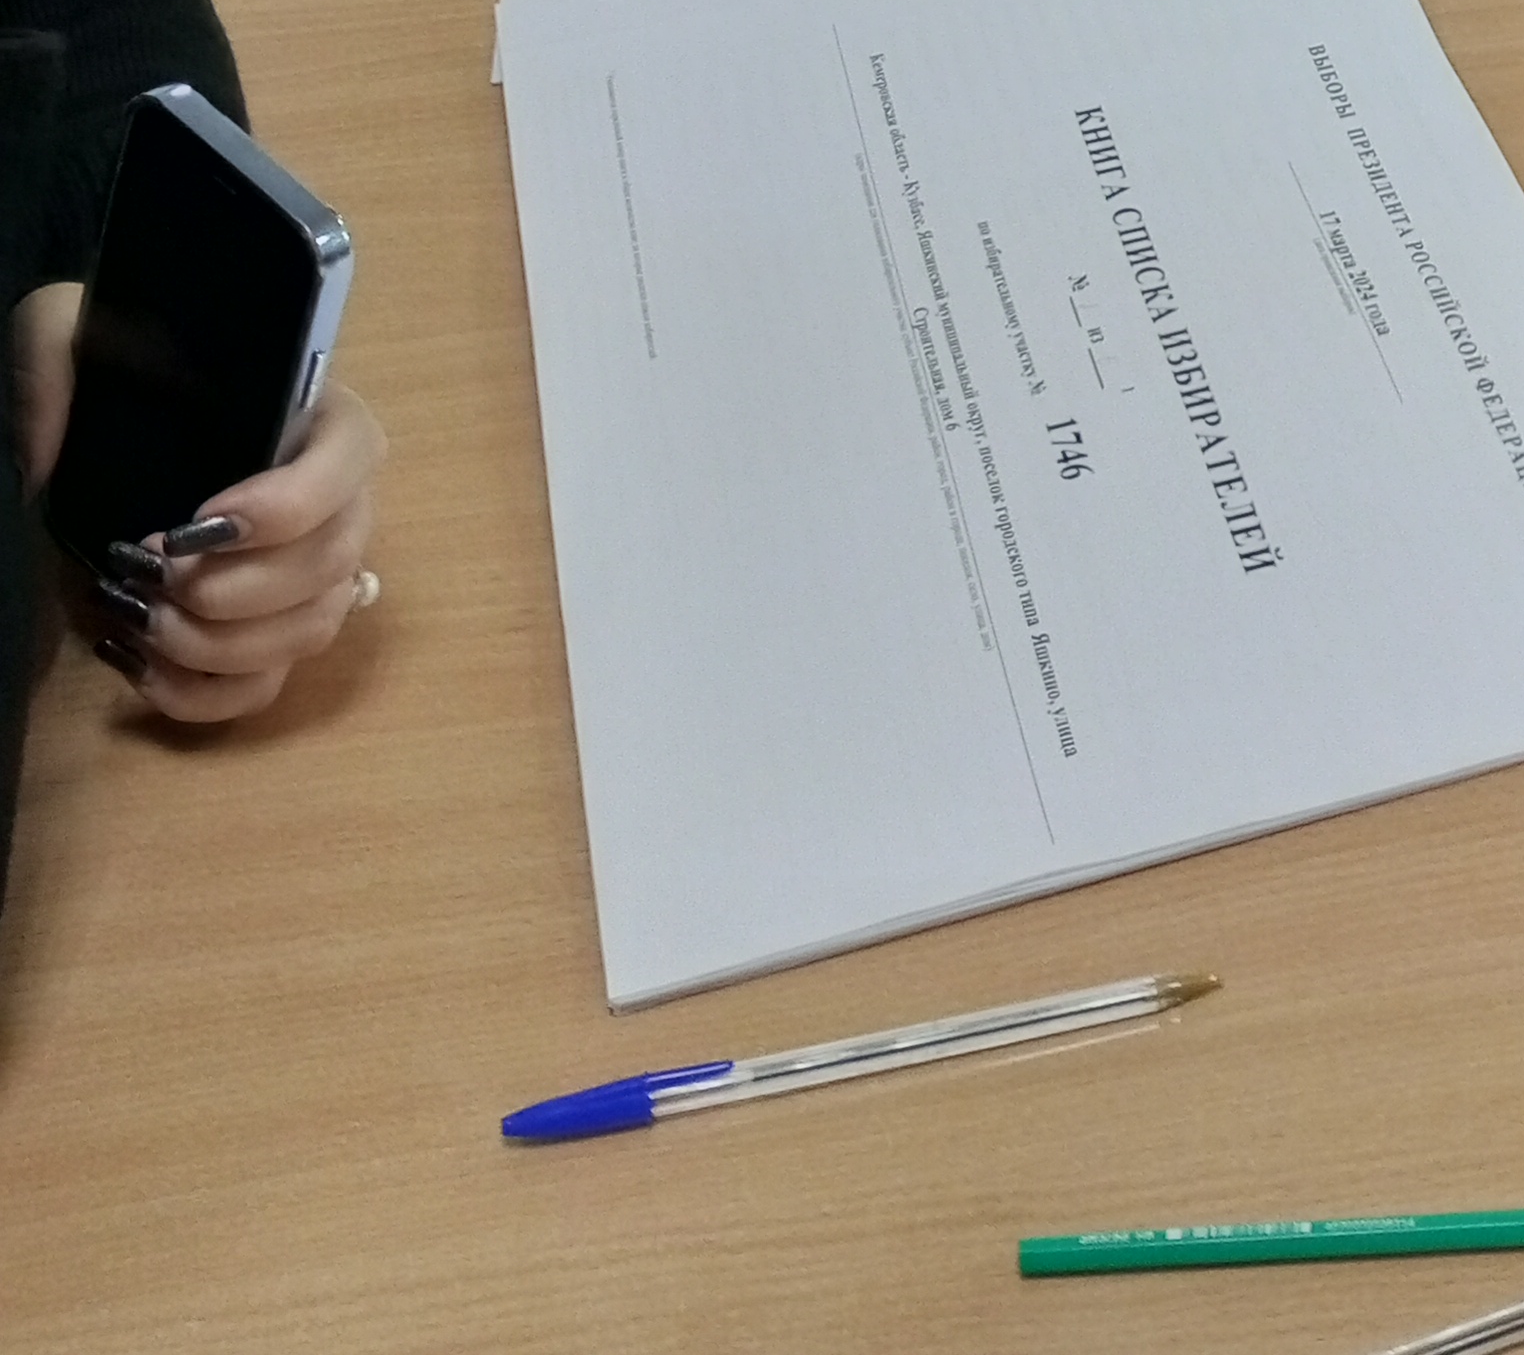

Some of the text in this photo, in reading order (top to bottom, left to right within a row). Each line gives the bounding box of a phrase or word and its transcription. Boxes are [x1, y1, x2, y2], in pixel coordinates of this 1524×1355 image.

[864, 52, 904, 128] Кемеровская
[886, 126, 914, 174] область
[975, 220, 992, 237] по
[1303, 42, 1359, 120] ВЫБОРЫ
[1345, 125, 1419, 238] ПРЕЗИДЕНТА
[1403, 237, 1493, 373] РОССИЙСКОЙ
[1318, 209, 1341, 227] 17
[913, 228, 951, 301] Яшкинский
[1321, 227, 1358, 271] марта
[976, 235, 1026, 332] избирательному
[1347, 268, 1379, 302] 2024
[1072, 103, 1287, 576] КНИГА СПИСКА ИЗБИРАТЕЛЕЙ
[1086, 326, 1106, 344] из
[1363, 302, 1392, 337] года
[906, 305, 960, 433] Строительная, дом 6
[931, 298, 980, 401] муниципальный
[1007, 330, 1039, 380] участку
[960, 400, 990, 446] округ,
[1042, 414, 1095, 483] 1746
[975, 445, 1007, 505] поселок
[989, 505, 1030, 589] городского
[1016, 590, 1041, 627] типа
[1026, 631, 1067, 706] Яшкино,
[1046, 705, 1079, 760] улица
